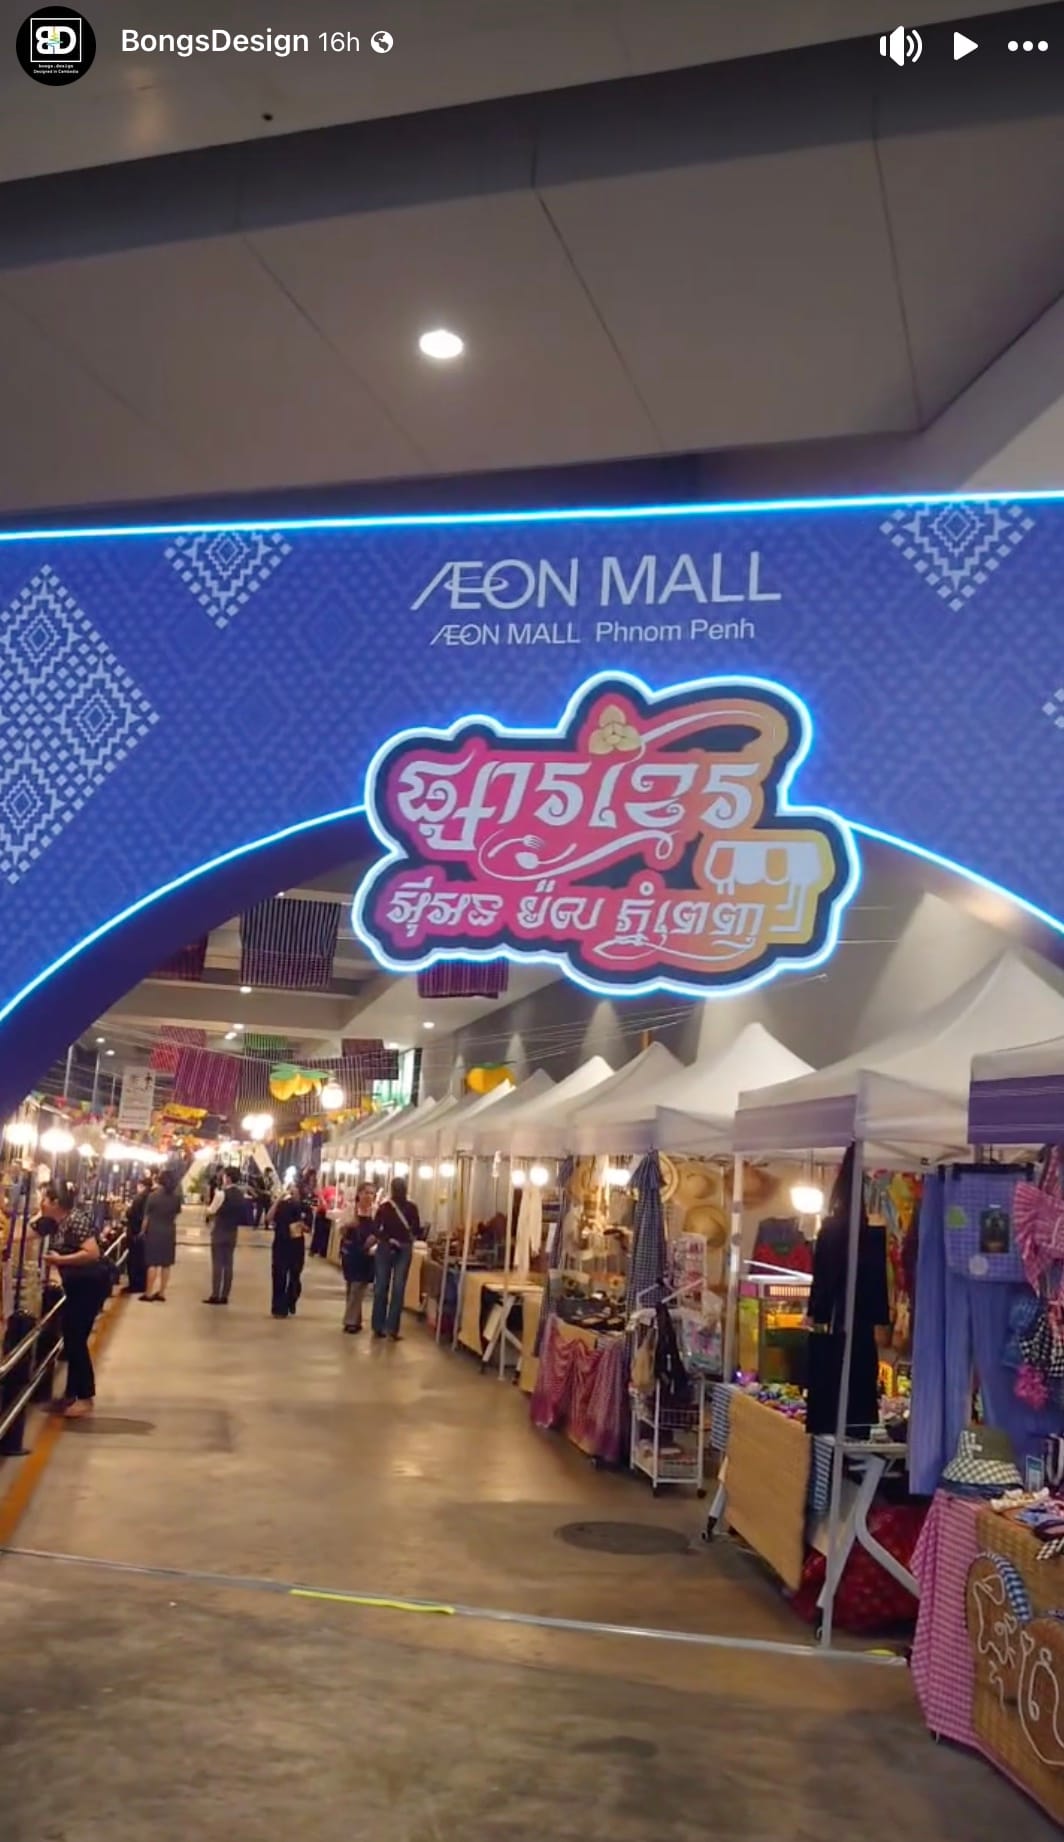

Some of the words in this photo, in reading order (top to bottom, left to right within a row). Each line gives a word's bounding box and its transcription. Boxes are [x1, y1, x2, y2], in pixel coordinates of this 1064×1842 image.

[600, 551, 782, 607] MALL
[507, 621, 581, 646] MALL
[596, 621, 682, 643] Phnom
[690, 618, 756, 641] Penh
